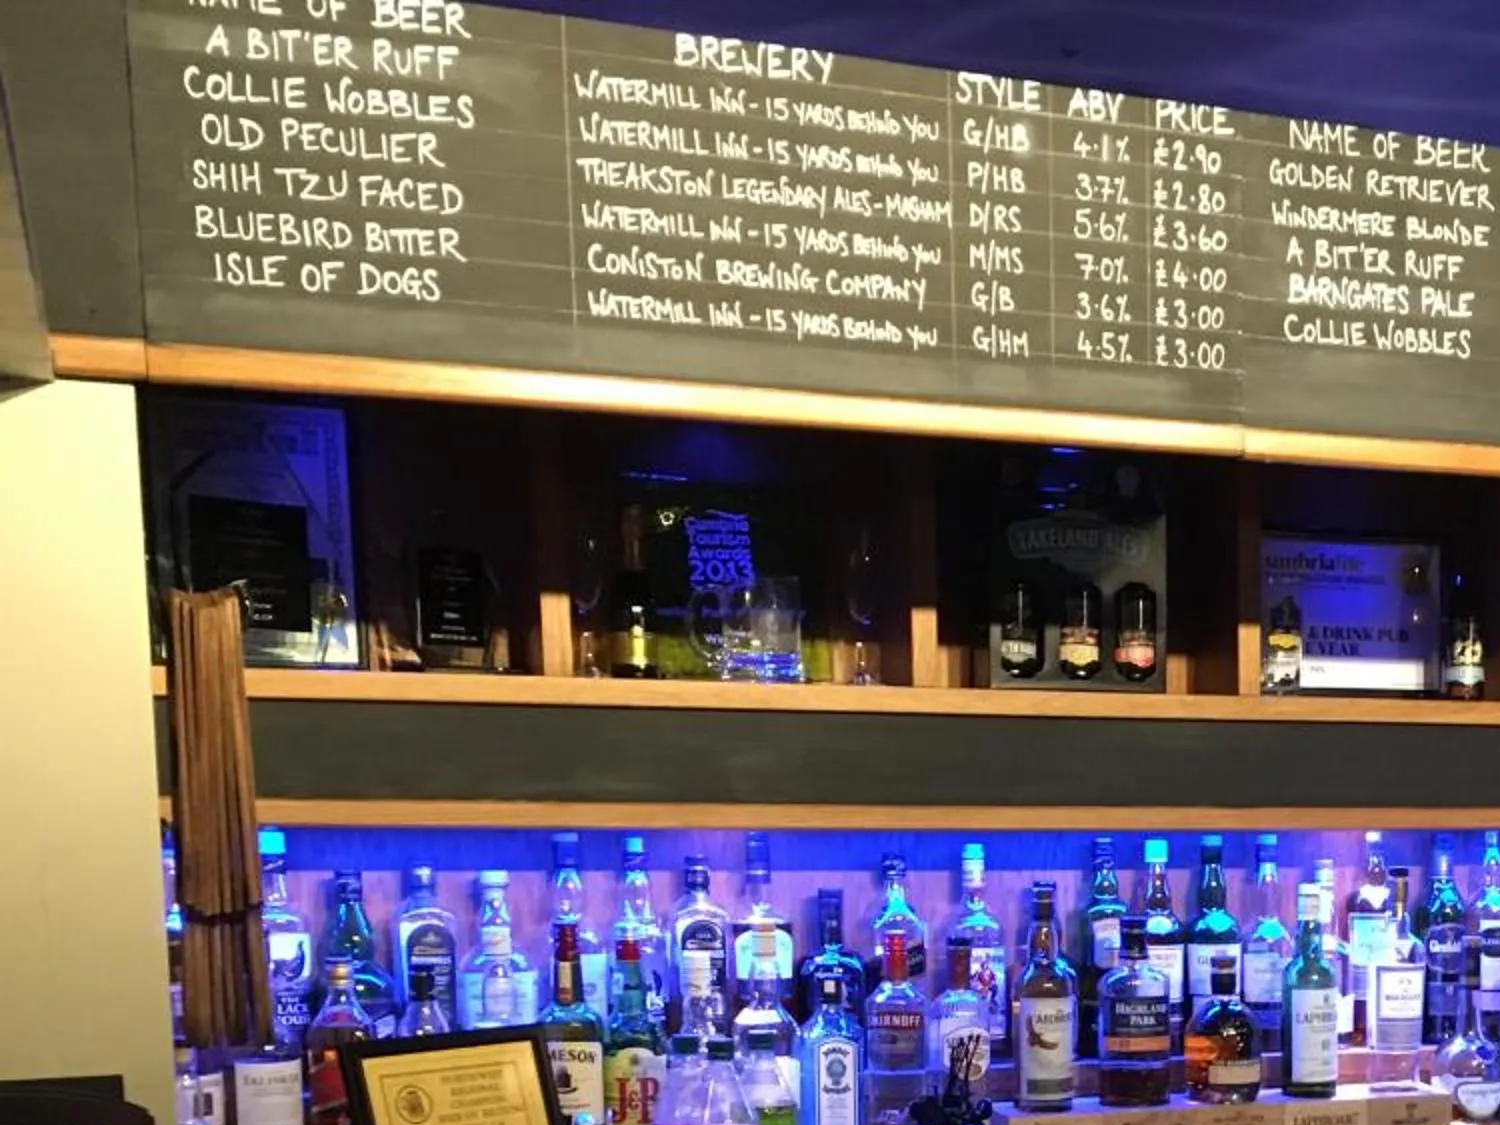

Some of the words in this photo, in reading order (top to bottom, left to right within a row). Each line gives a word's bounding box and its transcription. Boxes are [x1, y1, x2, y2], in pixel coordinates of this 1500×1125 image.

[372, 0, 473, 39] BEER
[205, 23, 230, 57] A
[246, 27, 359, 70] BIT'ER
[372, 38, 460, 81] RUFF
[673, 32, 836, 85] BREWERY
[183, 65, 306, 111] COLLIE
[323, 78, 476, 129] WOBBLES
[574, 69, 702, 110] WATERMILL
[709, 87, 748, 117] INN
[765, 97, 790, 122] 15
[793, 102, 845, 132] YARDS
[902, 113, 940, 141] YOU
[955, 71, 1042, 112] STYLE
[1067, 87, 1126, 124] ABV
[1155, 99, 1236, 136] PRICE
[201, 113, 264, 151] OLD
[280, 117, 447, 168] PECULIER
[579, 112, 709, 157] WATERMILL
[715, 131, 750, 160] INN
[963, 116, 1031, 154] G/HB
[1288, 119, 1362, 157] NAME
[1372, 131, 1400, 161] OF
[192, 159, 262, 197] SHIH
[274, 166, 348, 200] TZU
[359, 174, 464, 216] FACED
[575, 157, 716, 198] THEAKSTON
[720, 172, 828, 219] LEGENDARY
[967, 161, 1026, 195] P/HB
[1269, 158, 1354, 193] GOLDEN
[1366, 169, 1496, 212] RETRIEVER
[194, 204, 353, 251] BLUEBIRD
[365, 221, 468, 263] BITTER
[581, 200, 705, 239] WATERMILL
[969, 201, 1023, 235] D/RS
[1271, 198, 1396, 237] WINDERMERE
[1405, 215, 1491, 247] BLONDE
[214, 252, 288, 288] ISLE
[300, 258, 345, 294] OF
[357, 263, 441, 302] DOGS
[587, 244, 705, 283] CONISTON
[715, 258, 820, 293] BREWING
[825, 269, 927, 313] COMPANY
[968, 239, 1025, 276] M/MS
[1286, 235, 1304, 267] A
[1404, 249, 1465, 282] RUFF
[587, 288, 702, 325] WATERMILL
[708, 301, 744, 329] INN
[765, 308, 788, 332] 15
[791, 310, 840, 342] YARDS
[906, 325, 939, 351] YOU
[970, 280, 1016, 316] G/B
[1287, 273, 1410, 315] BARNGATES
[1420, 286, 1475, 318] PALE
[971, 324, 1030, 359] G/HM
[1283, 313, 1367, 347] COLLIE
[1373, 319, 1472, 360] WOBBLES
[688, 560, 755, 582] 2013
[547, 1049, 596, 1065] MESON
